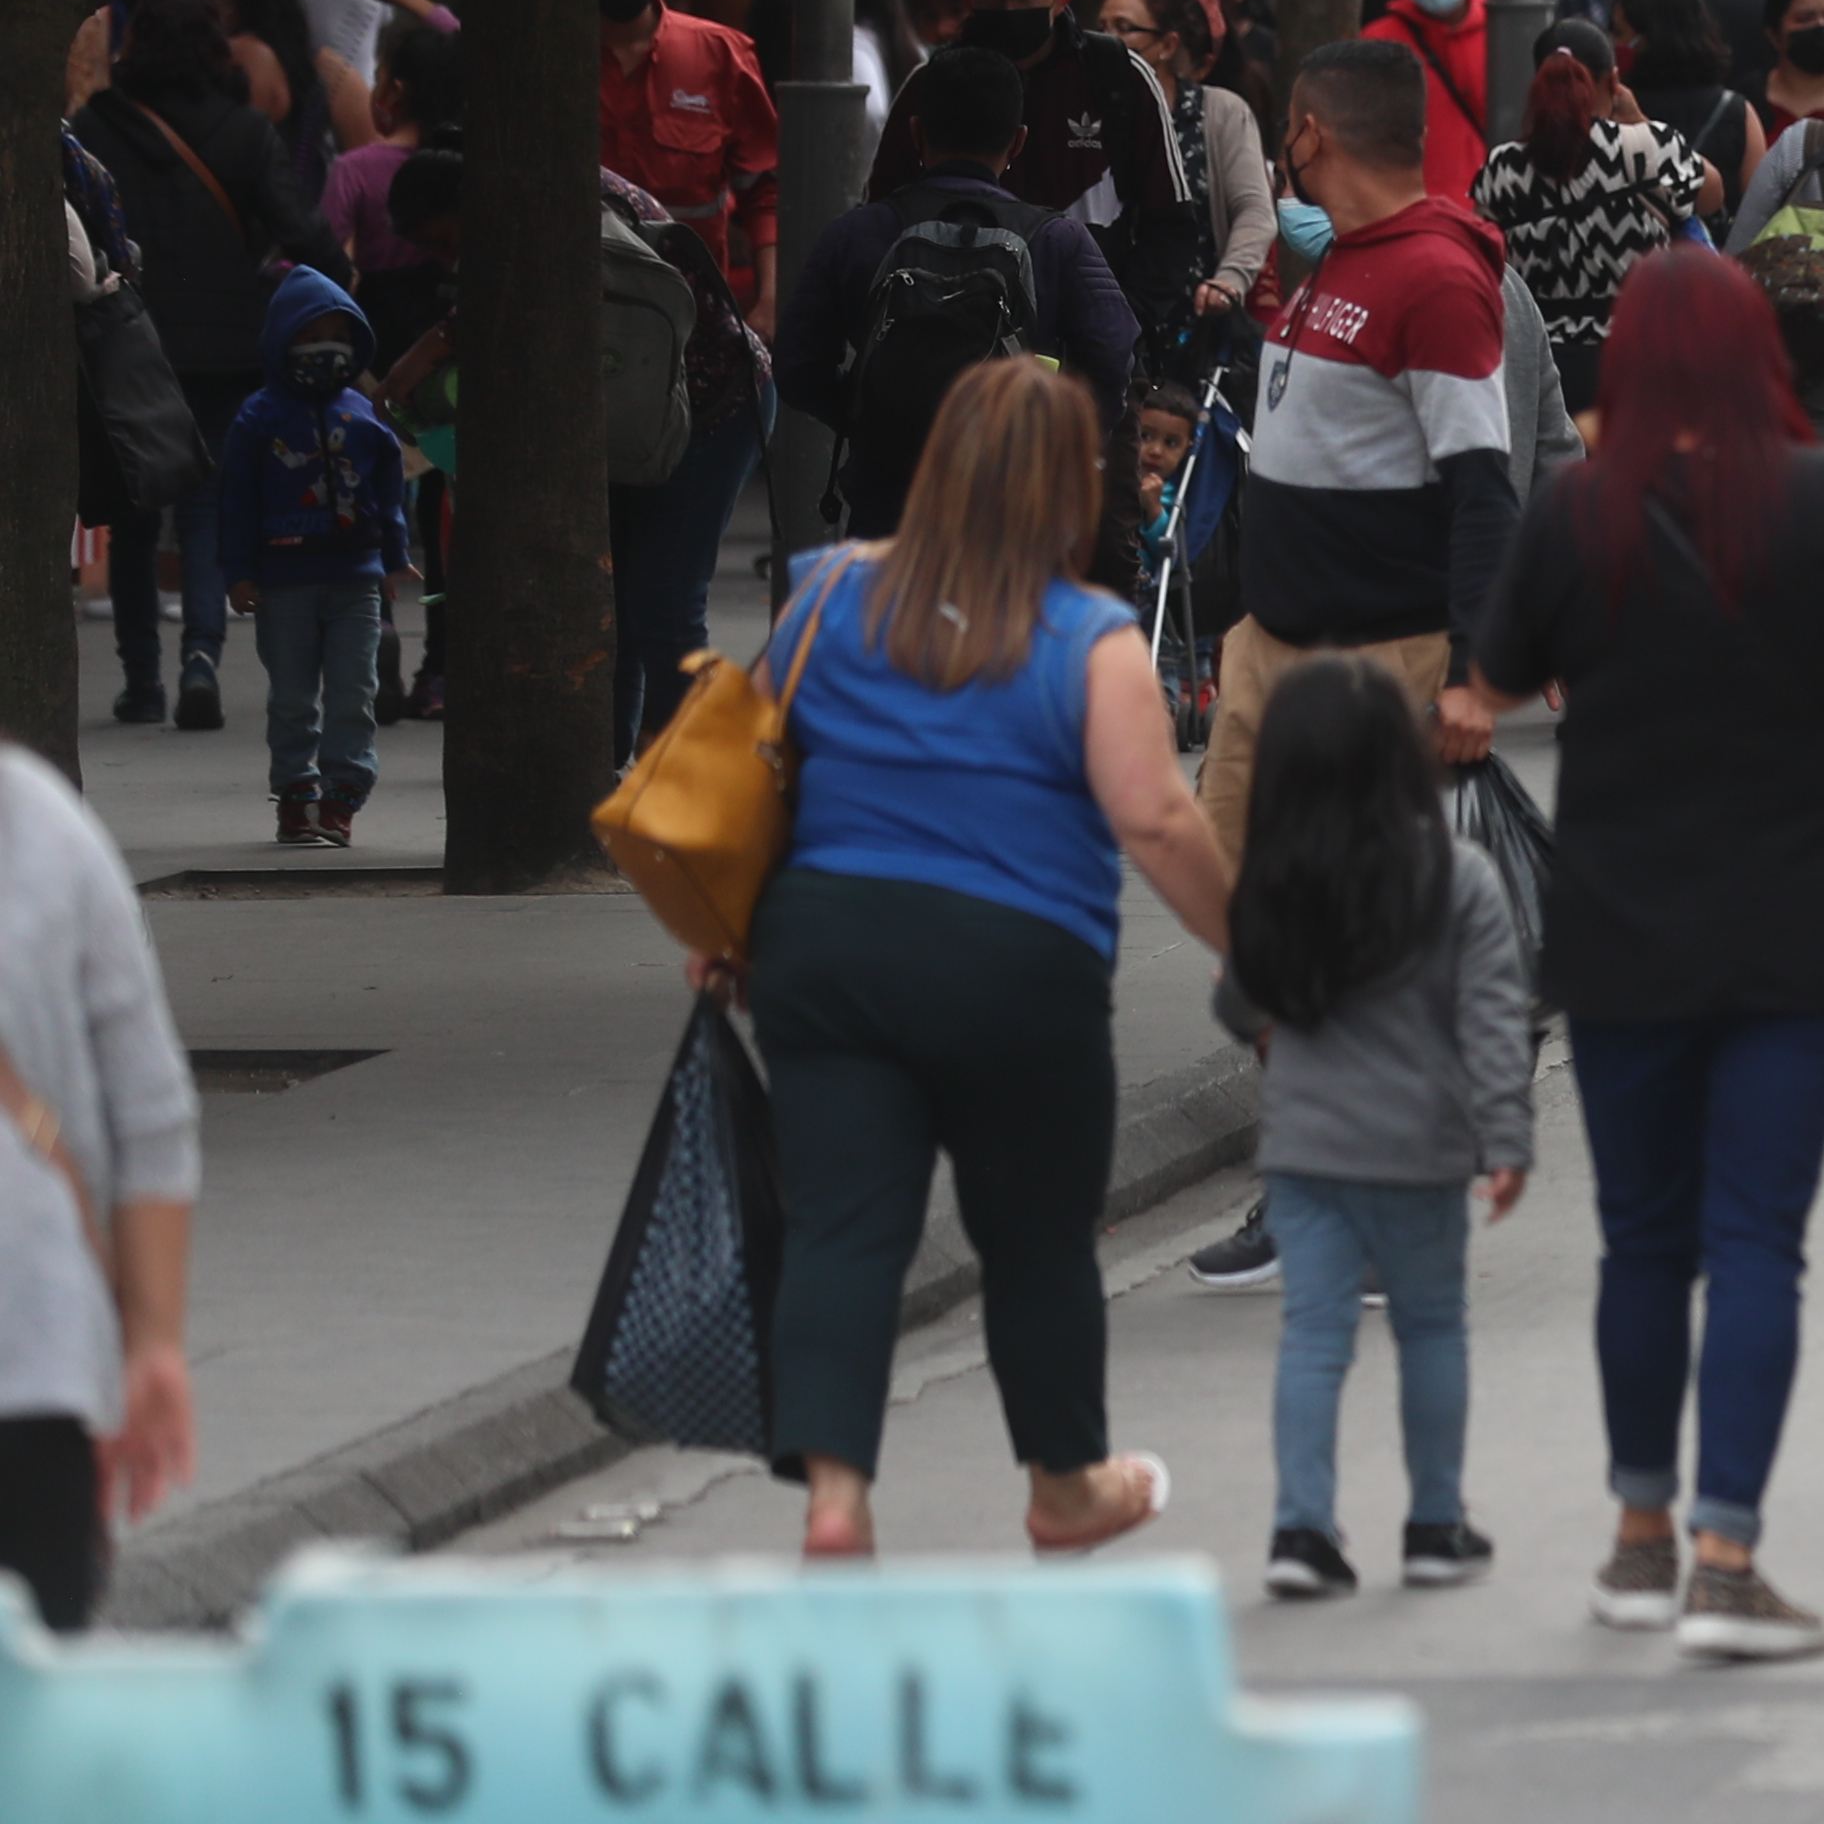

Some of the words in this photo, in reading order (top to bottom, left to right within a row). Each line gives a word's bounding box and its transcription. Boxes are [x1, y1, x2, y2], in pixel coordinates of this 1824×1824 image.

[1067, 136, 1103, 150] adidas
[322, 1677, 477, 1810] 15
[582, 1666, 1084, 1808] CALLE
